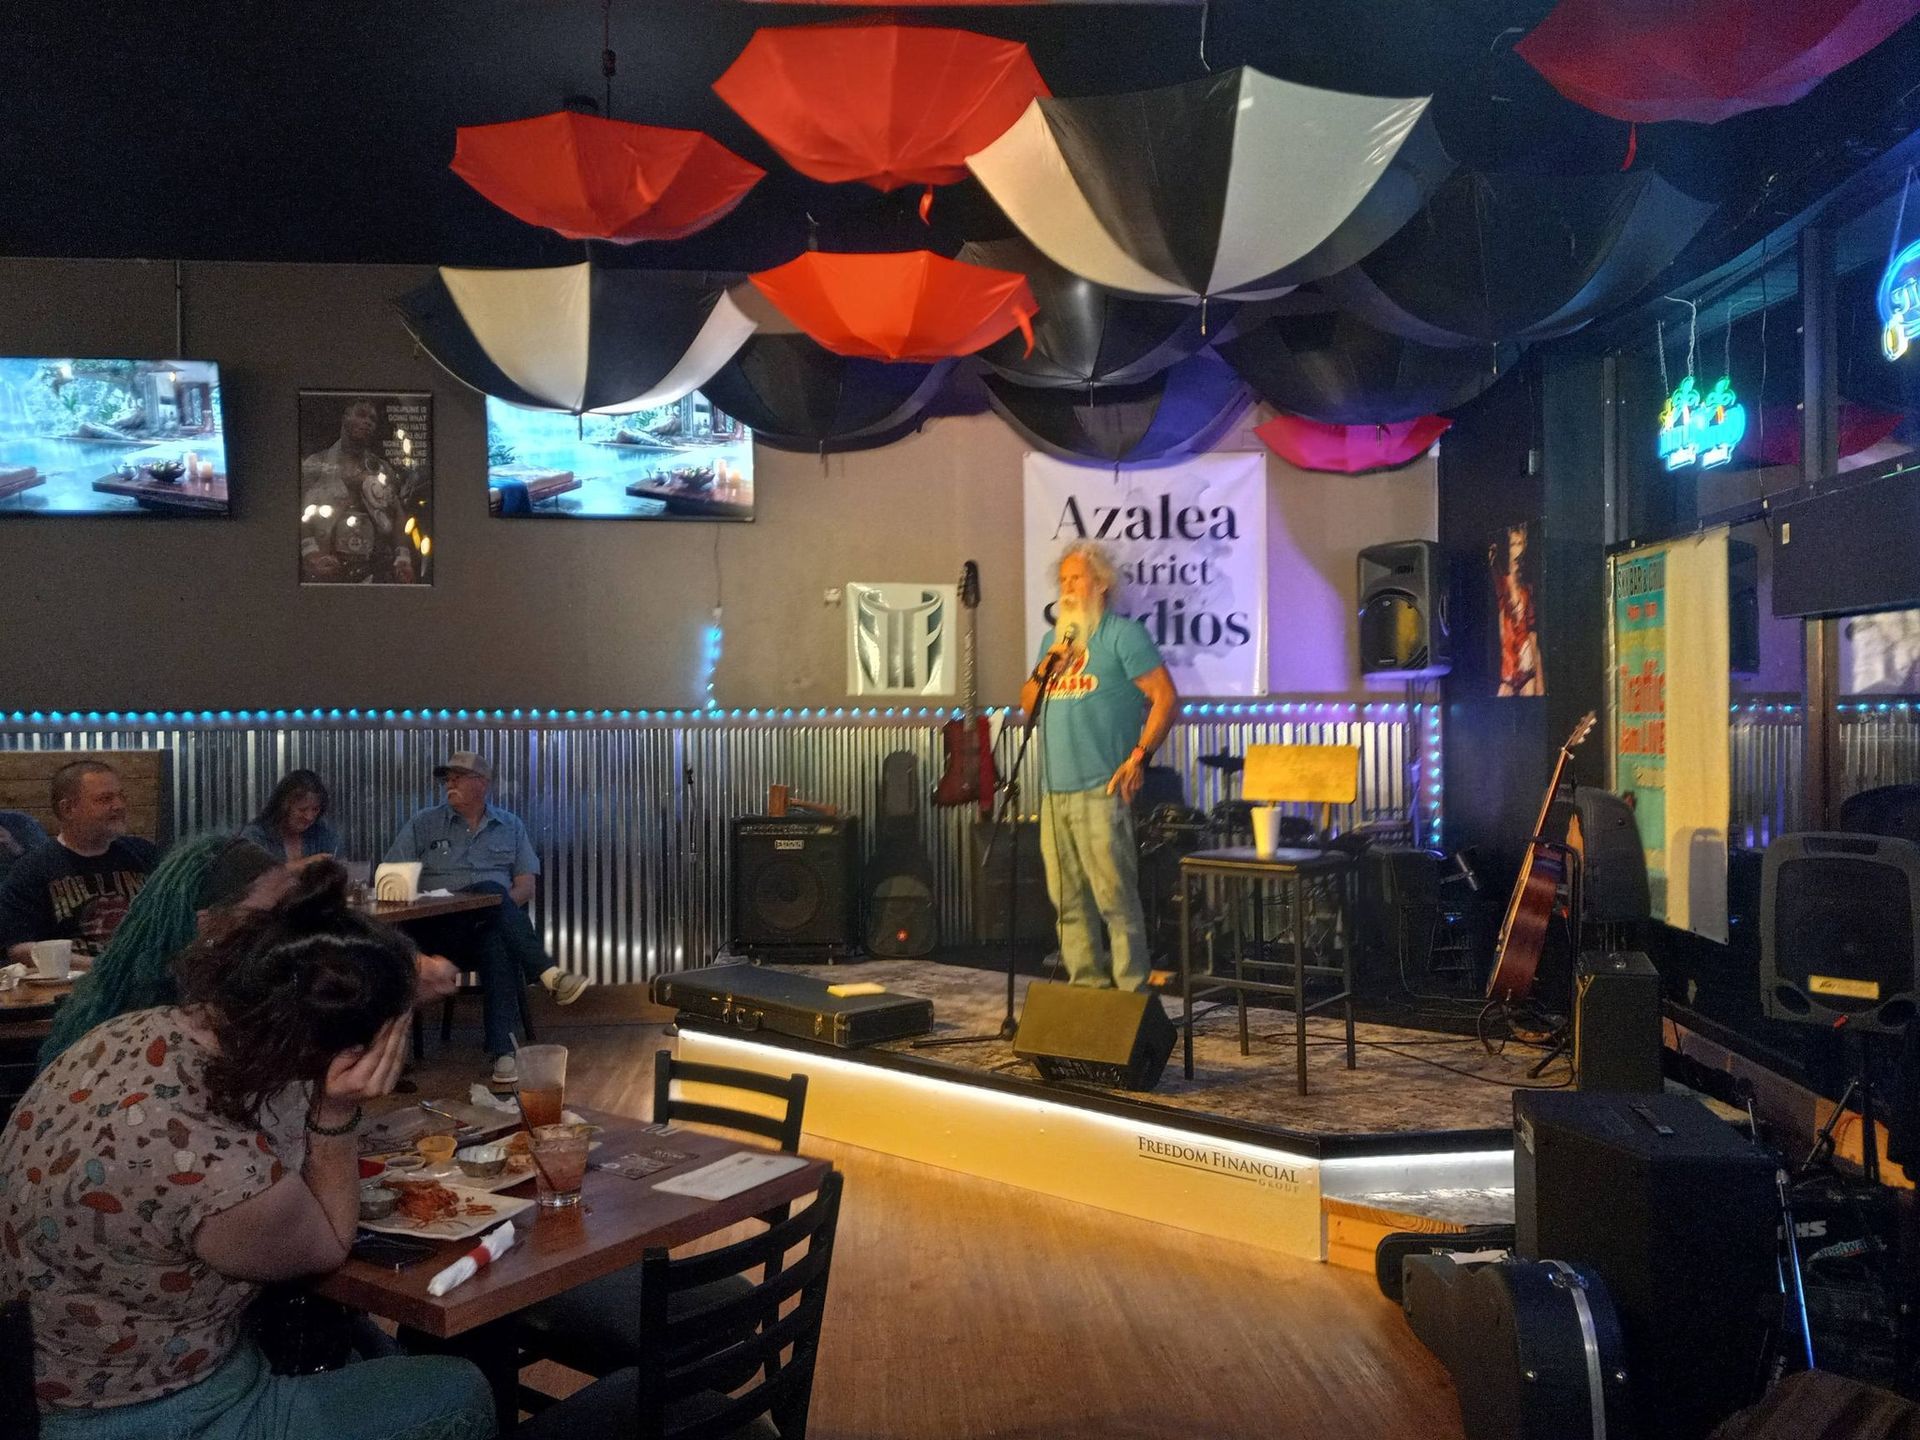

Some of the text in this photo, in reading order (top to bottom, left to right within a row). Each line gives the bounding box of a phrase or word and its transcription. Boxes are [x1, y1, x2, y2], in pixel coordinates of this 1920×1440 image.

[1050, 493, 1240, 541] Azalea
[1119, 554, 1216, 586] strict
[1137, 1136, 1299, 1184] FREEDOM FINANCIAL
